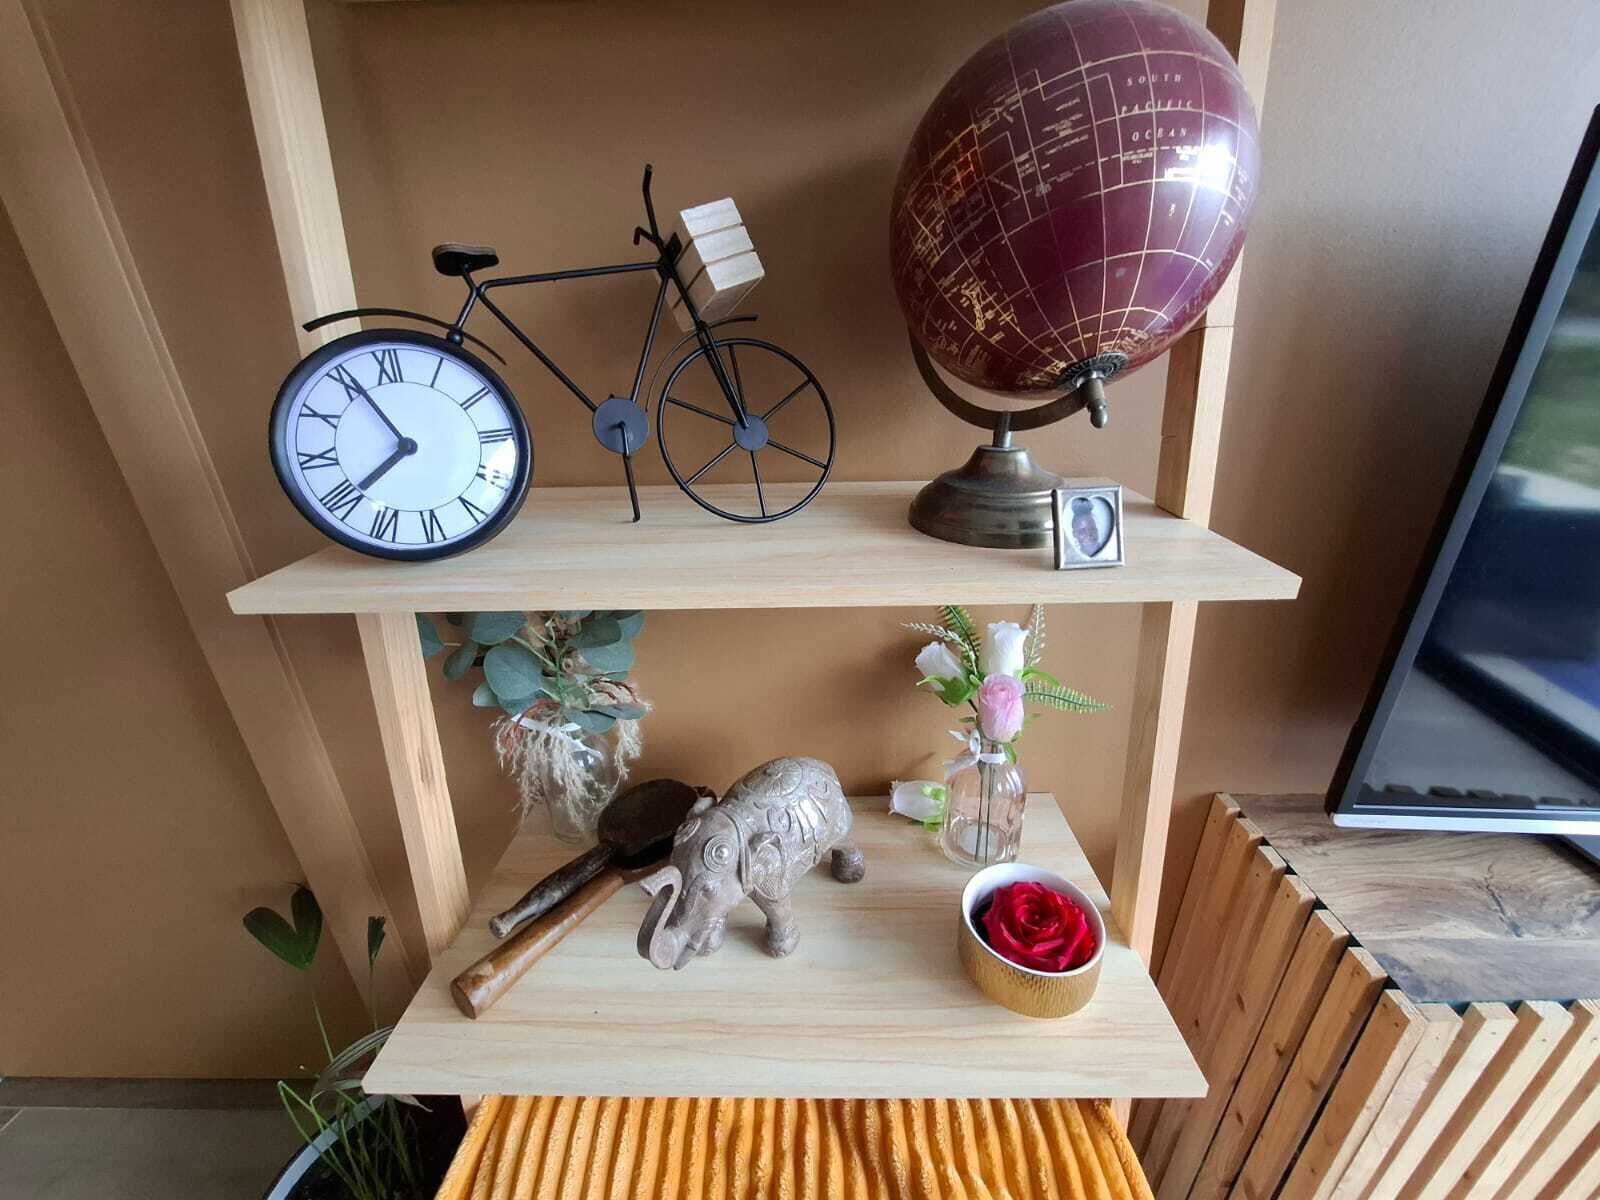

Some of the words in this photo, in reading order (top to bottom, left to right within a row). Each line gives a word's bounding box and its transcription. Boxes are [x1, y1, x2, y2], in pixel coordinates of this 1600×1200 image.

[1127, 74, 1182, 86] SOUTH
[1121, 100, 1192, 115] PACIFIC
[1132, 128, 1187, 142] OCEAN
[372, 349, 404, 385] XII
[460, 387, 490, 411] II
[299, 404, 341, 429] X
[478, 428, 513, 444] III
[297, 447, 339, 470] IX
[320, 480, 363, 521] VIII
[457, 496, 490, 524] V
[370, 507, 399, 543] VII
[420, 510, 447, 543] VI
